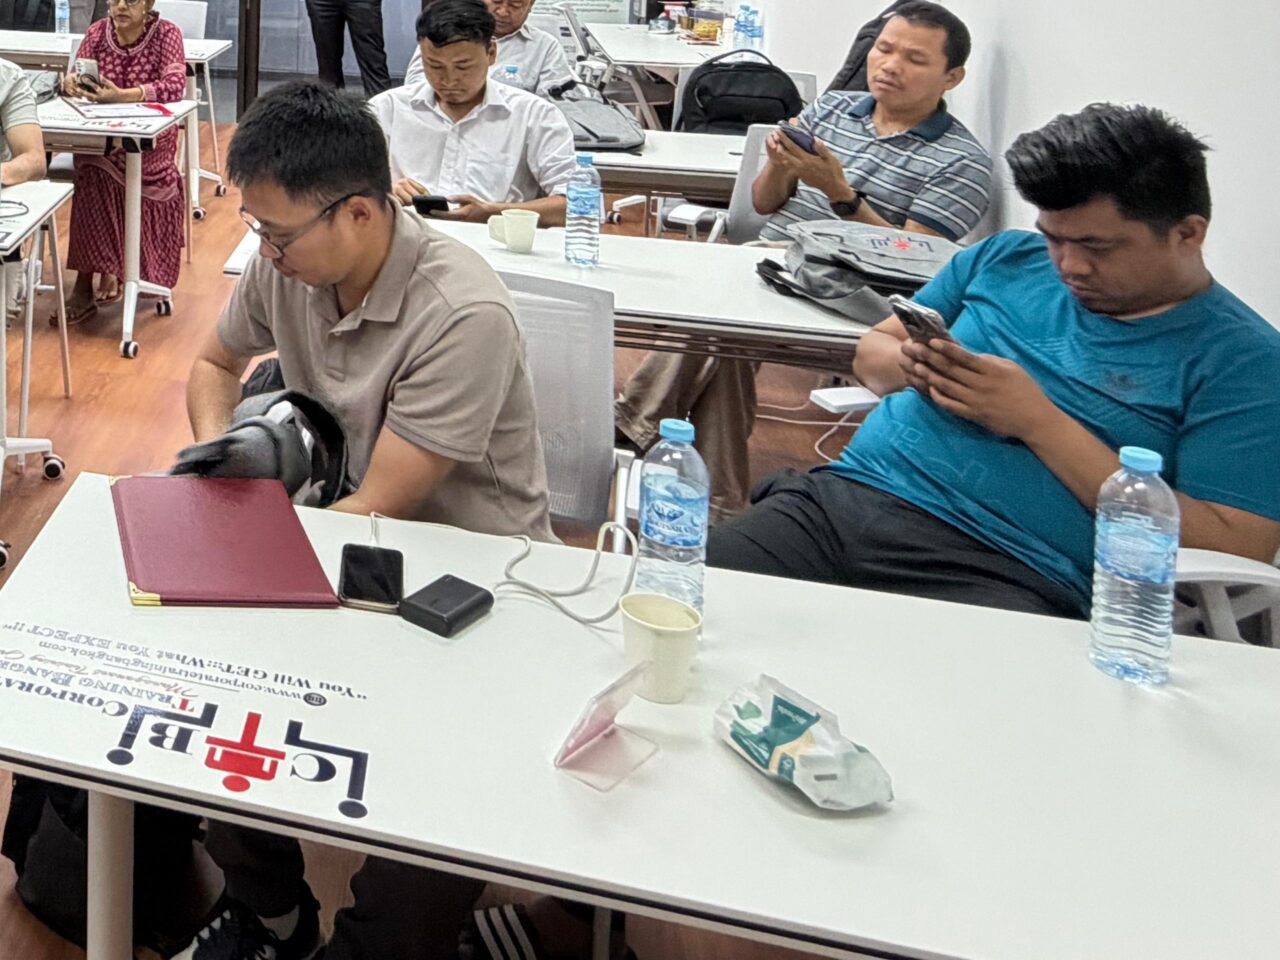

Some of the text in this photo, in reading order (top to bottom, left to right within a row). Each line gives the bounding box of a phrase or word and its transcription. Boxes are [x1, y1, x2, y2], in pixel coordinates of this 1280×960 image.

[27, 625, 113, 650] EXPECT
[116, 642, 151, 658] You
[39, 640, 301, 700] www.corporatetrainingbangkok.com
[272, 673, 311, 689] Will
[79, 678, 195, 712] TRAINING
[148, 722, 201, 755] B
